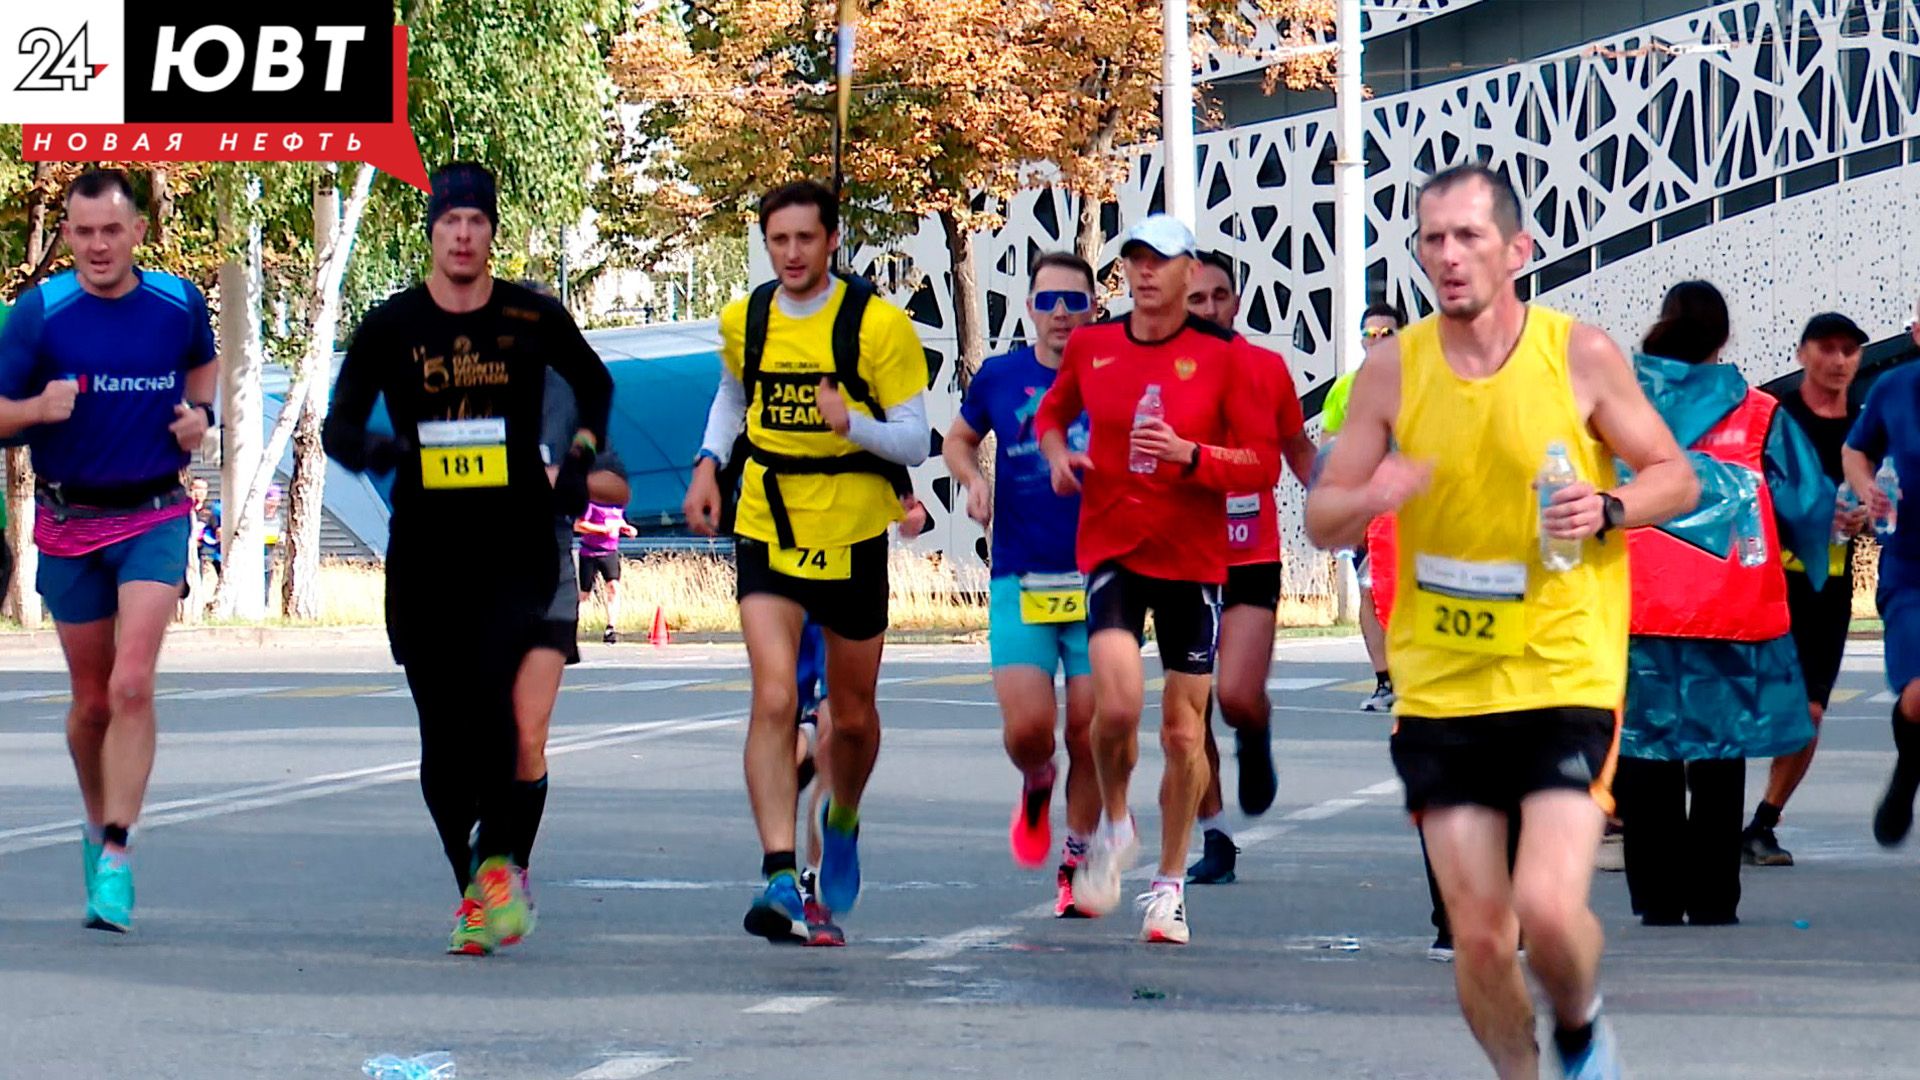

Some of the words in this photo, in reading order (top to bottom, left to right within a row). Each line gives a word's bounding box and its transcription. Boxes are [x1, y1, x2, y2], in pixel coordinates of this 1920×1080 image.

[93, 370, 176, 393] Капснаб
[440, 455, 484, 477] 181
[796, 547, 827, 570] 74
[1047, 595, 1077, 614] 76
[1434, 605, 1495, 640] 202
